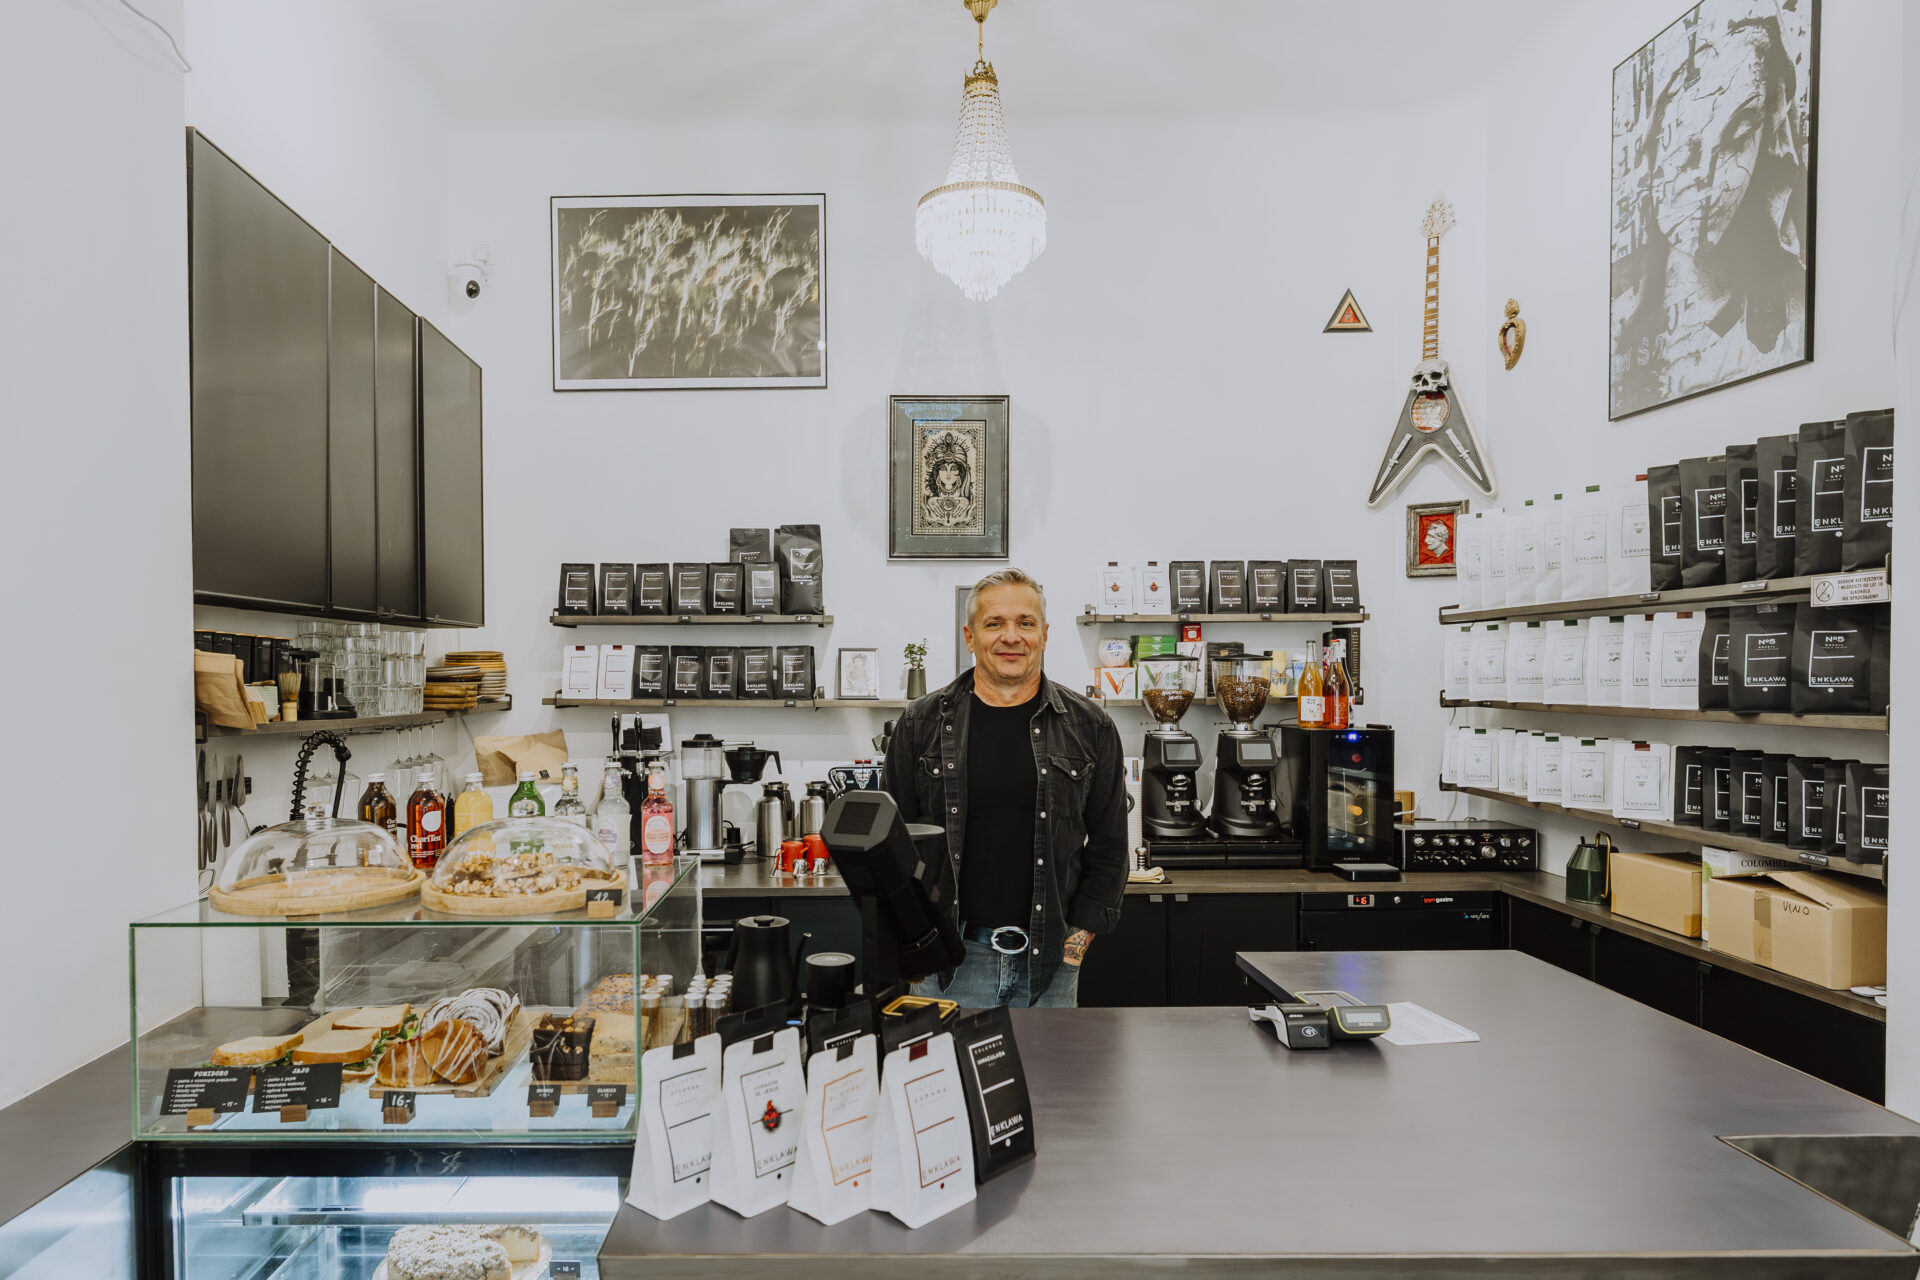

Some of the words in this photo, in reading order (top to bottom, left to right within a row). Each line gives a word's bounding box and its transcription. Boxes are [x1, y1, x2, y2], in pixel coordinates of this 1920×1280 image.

[1865, 507, 1894, 518] ENKL
[1815, 518, 1843, 528] ENKL
[1700, 538, 1724, 548] ENKL
[1747, 675, 1787, 683] ENKLAWA
[1811, 676, 1855, 684] ENKLAWA
[1864, 837, 1889, 845] ENKL
[1782, 900, 1810, 916] VINO
[990, 1113, 1024, 1137] ENKLAWA
[675, 1152, 712, 1175] ENKLAW
[922, 1155, 961, 1180] ENKLAWA
